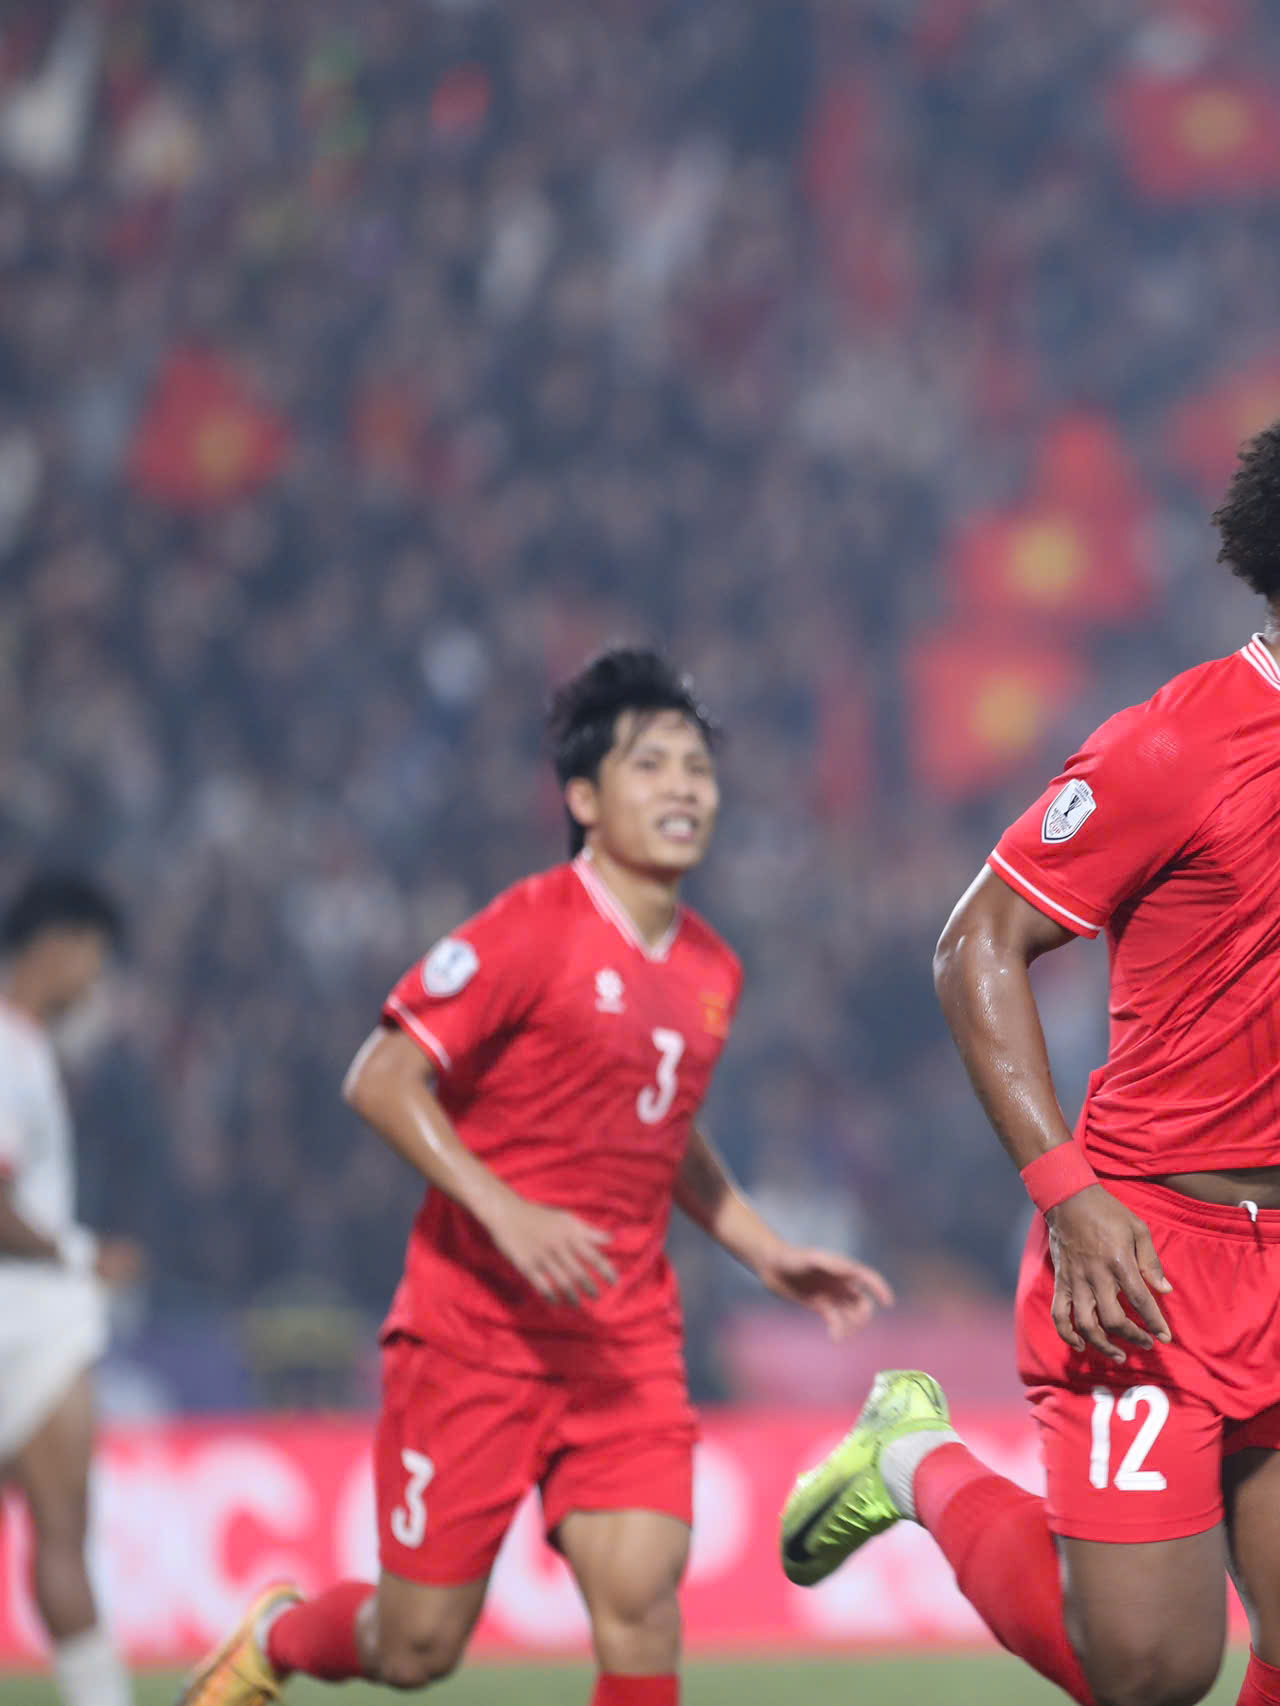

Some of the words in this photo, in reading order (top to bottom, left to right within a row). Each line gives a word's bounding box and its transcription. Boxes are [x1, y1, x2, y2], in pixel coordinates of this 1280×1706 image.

[637, 1027, 685, 1124] 3
[1089, 1385, 1170, 1491] 12
[391, 1448, 435, 1549] 3
